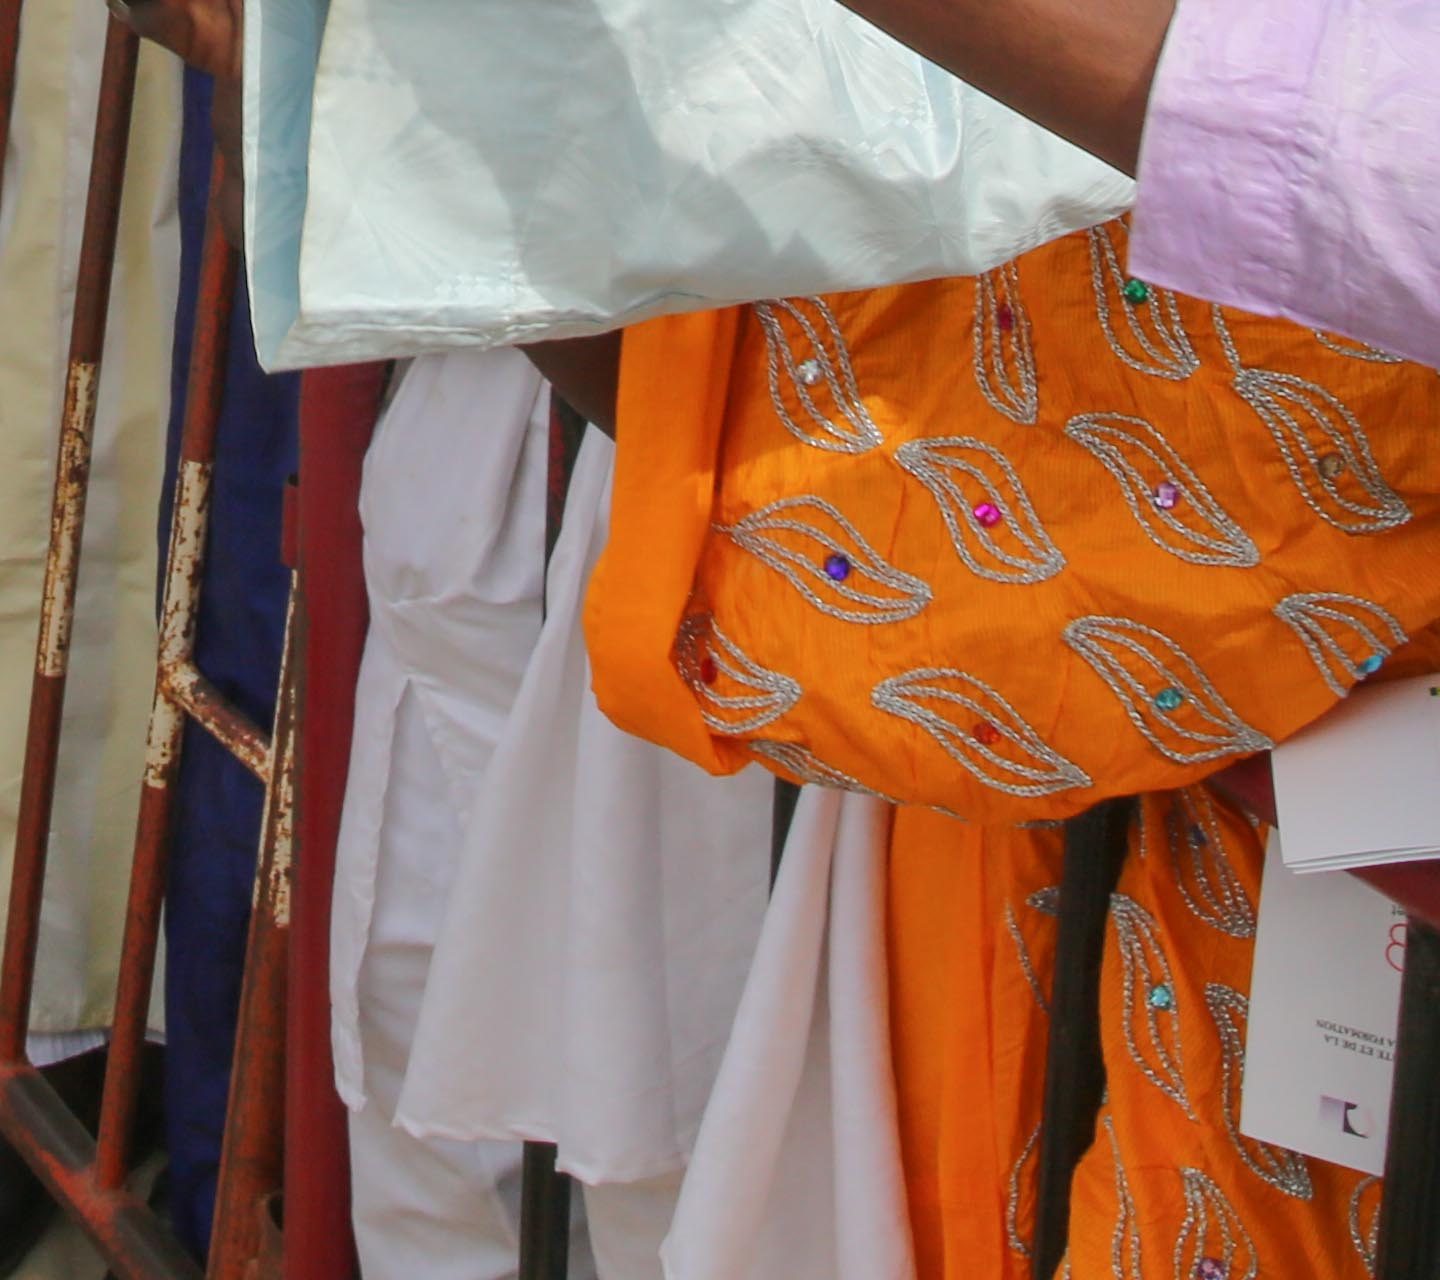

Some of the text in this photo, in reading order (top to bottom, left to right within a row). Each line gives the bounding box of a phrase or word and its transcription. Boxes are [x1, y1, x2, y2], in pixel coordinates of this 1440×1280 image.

[1316, 1019, 1385, 1046] FORMATION
[1324, 1035, 1338, 1046] LA
[1342, 1041, 1357, 1052] DE
[1360, 1045, 1374, 1057] ET
